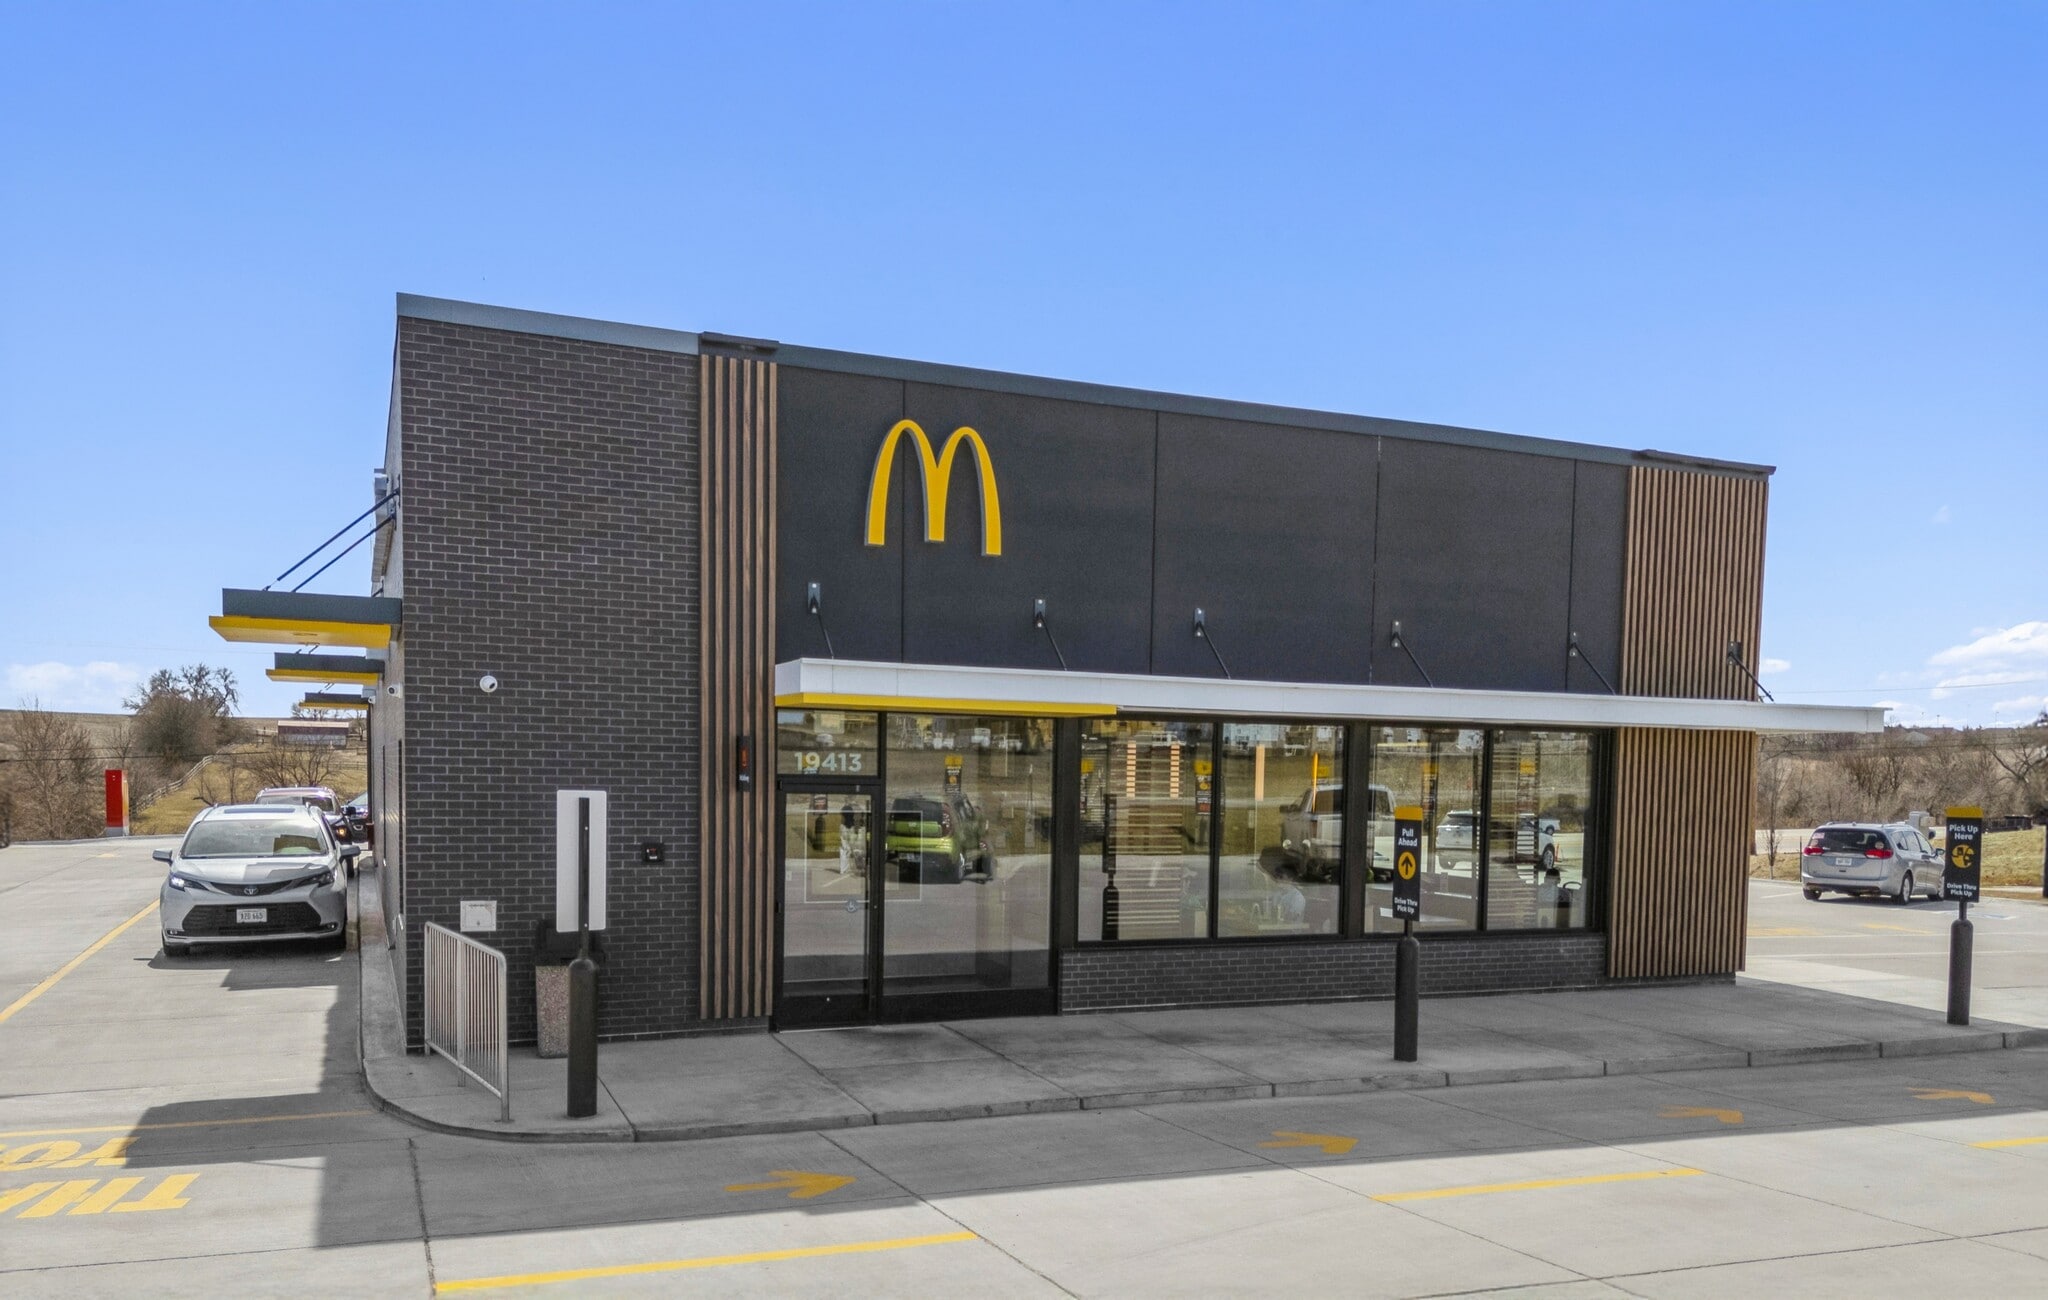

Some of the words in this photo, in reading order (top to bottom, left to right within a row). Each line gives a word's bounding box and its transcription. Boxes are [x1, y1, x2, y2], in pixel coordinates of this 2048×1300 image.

[794, 751, 862, 772] 19413
[1402, 828, 1414, 837] Pull
[1949, 824, 1966, 832] Pick
[1967, 825, 1978, 833] Up
[1398, 838, 1418, 846] Ahead
[0, 1136, 140, 1172] YO
